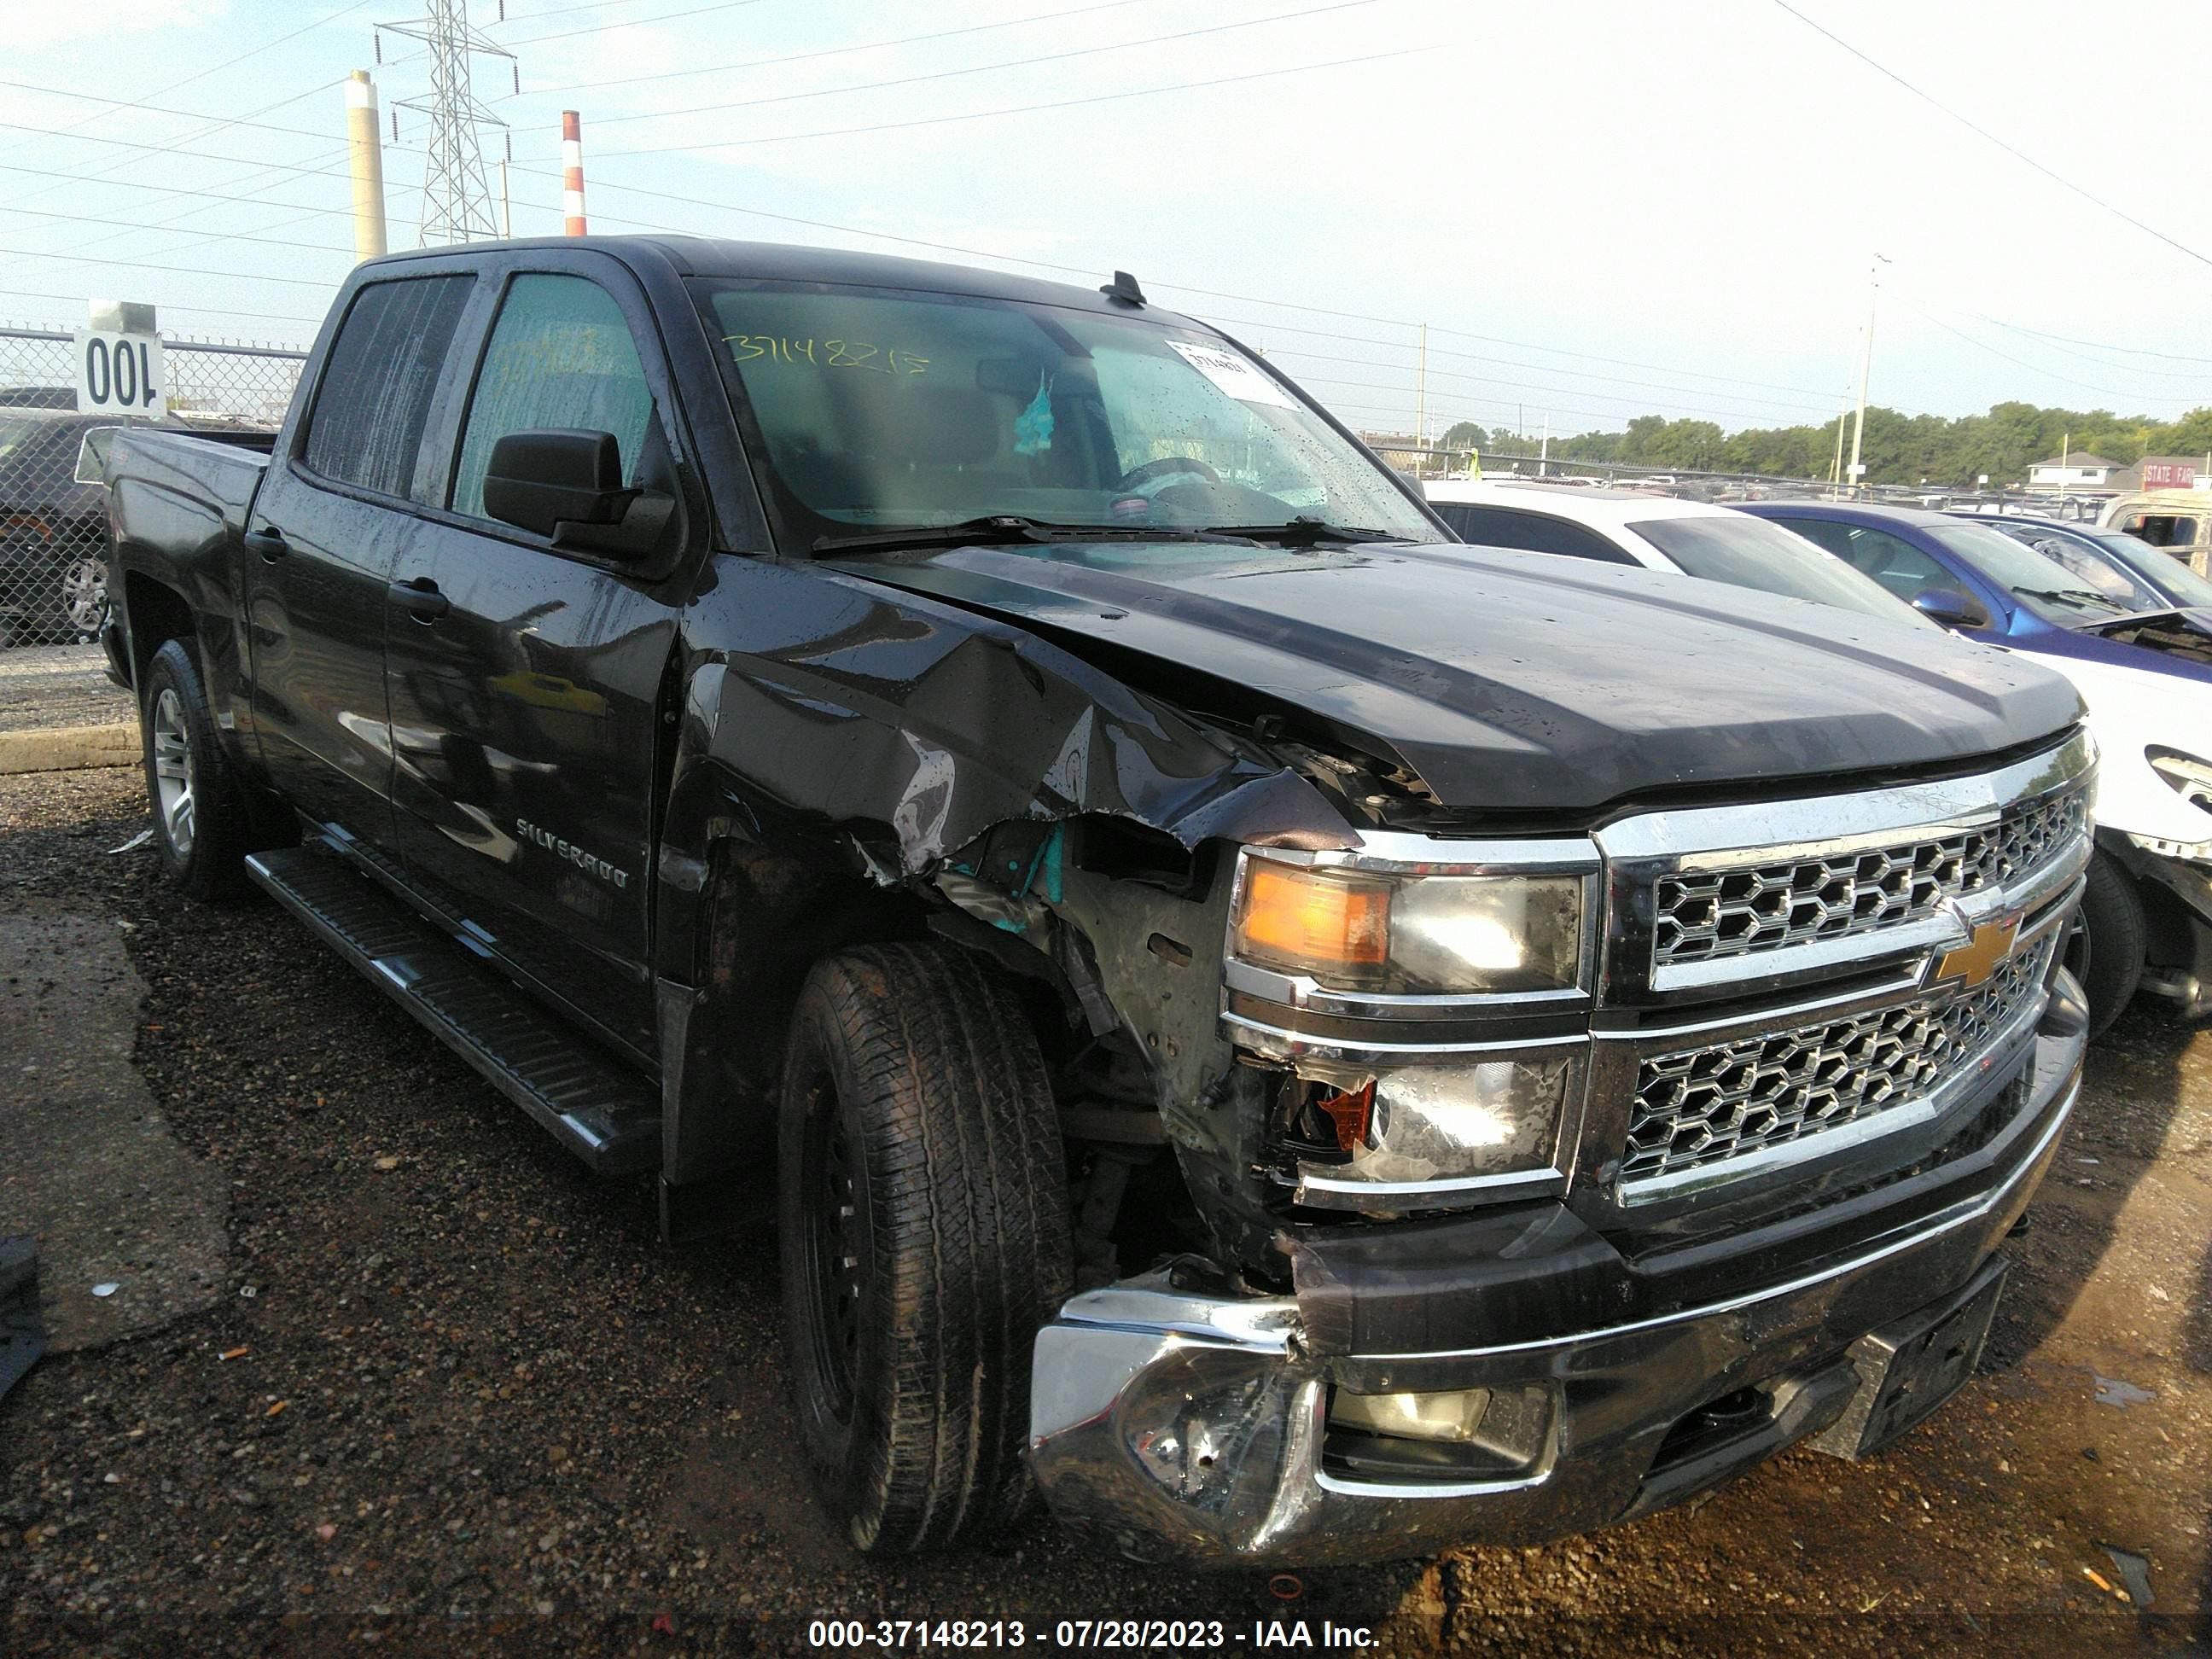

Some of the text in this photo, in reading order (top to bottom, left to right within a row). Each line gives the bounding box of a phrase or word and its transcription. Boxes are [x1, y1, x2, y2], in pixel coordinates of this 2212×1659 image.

[86, 337, 156, 408] 100
[2147, 465, 2172, 483] STATE
[516, 818, 629, 888] SILVERADO
